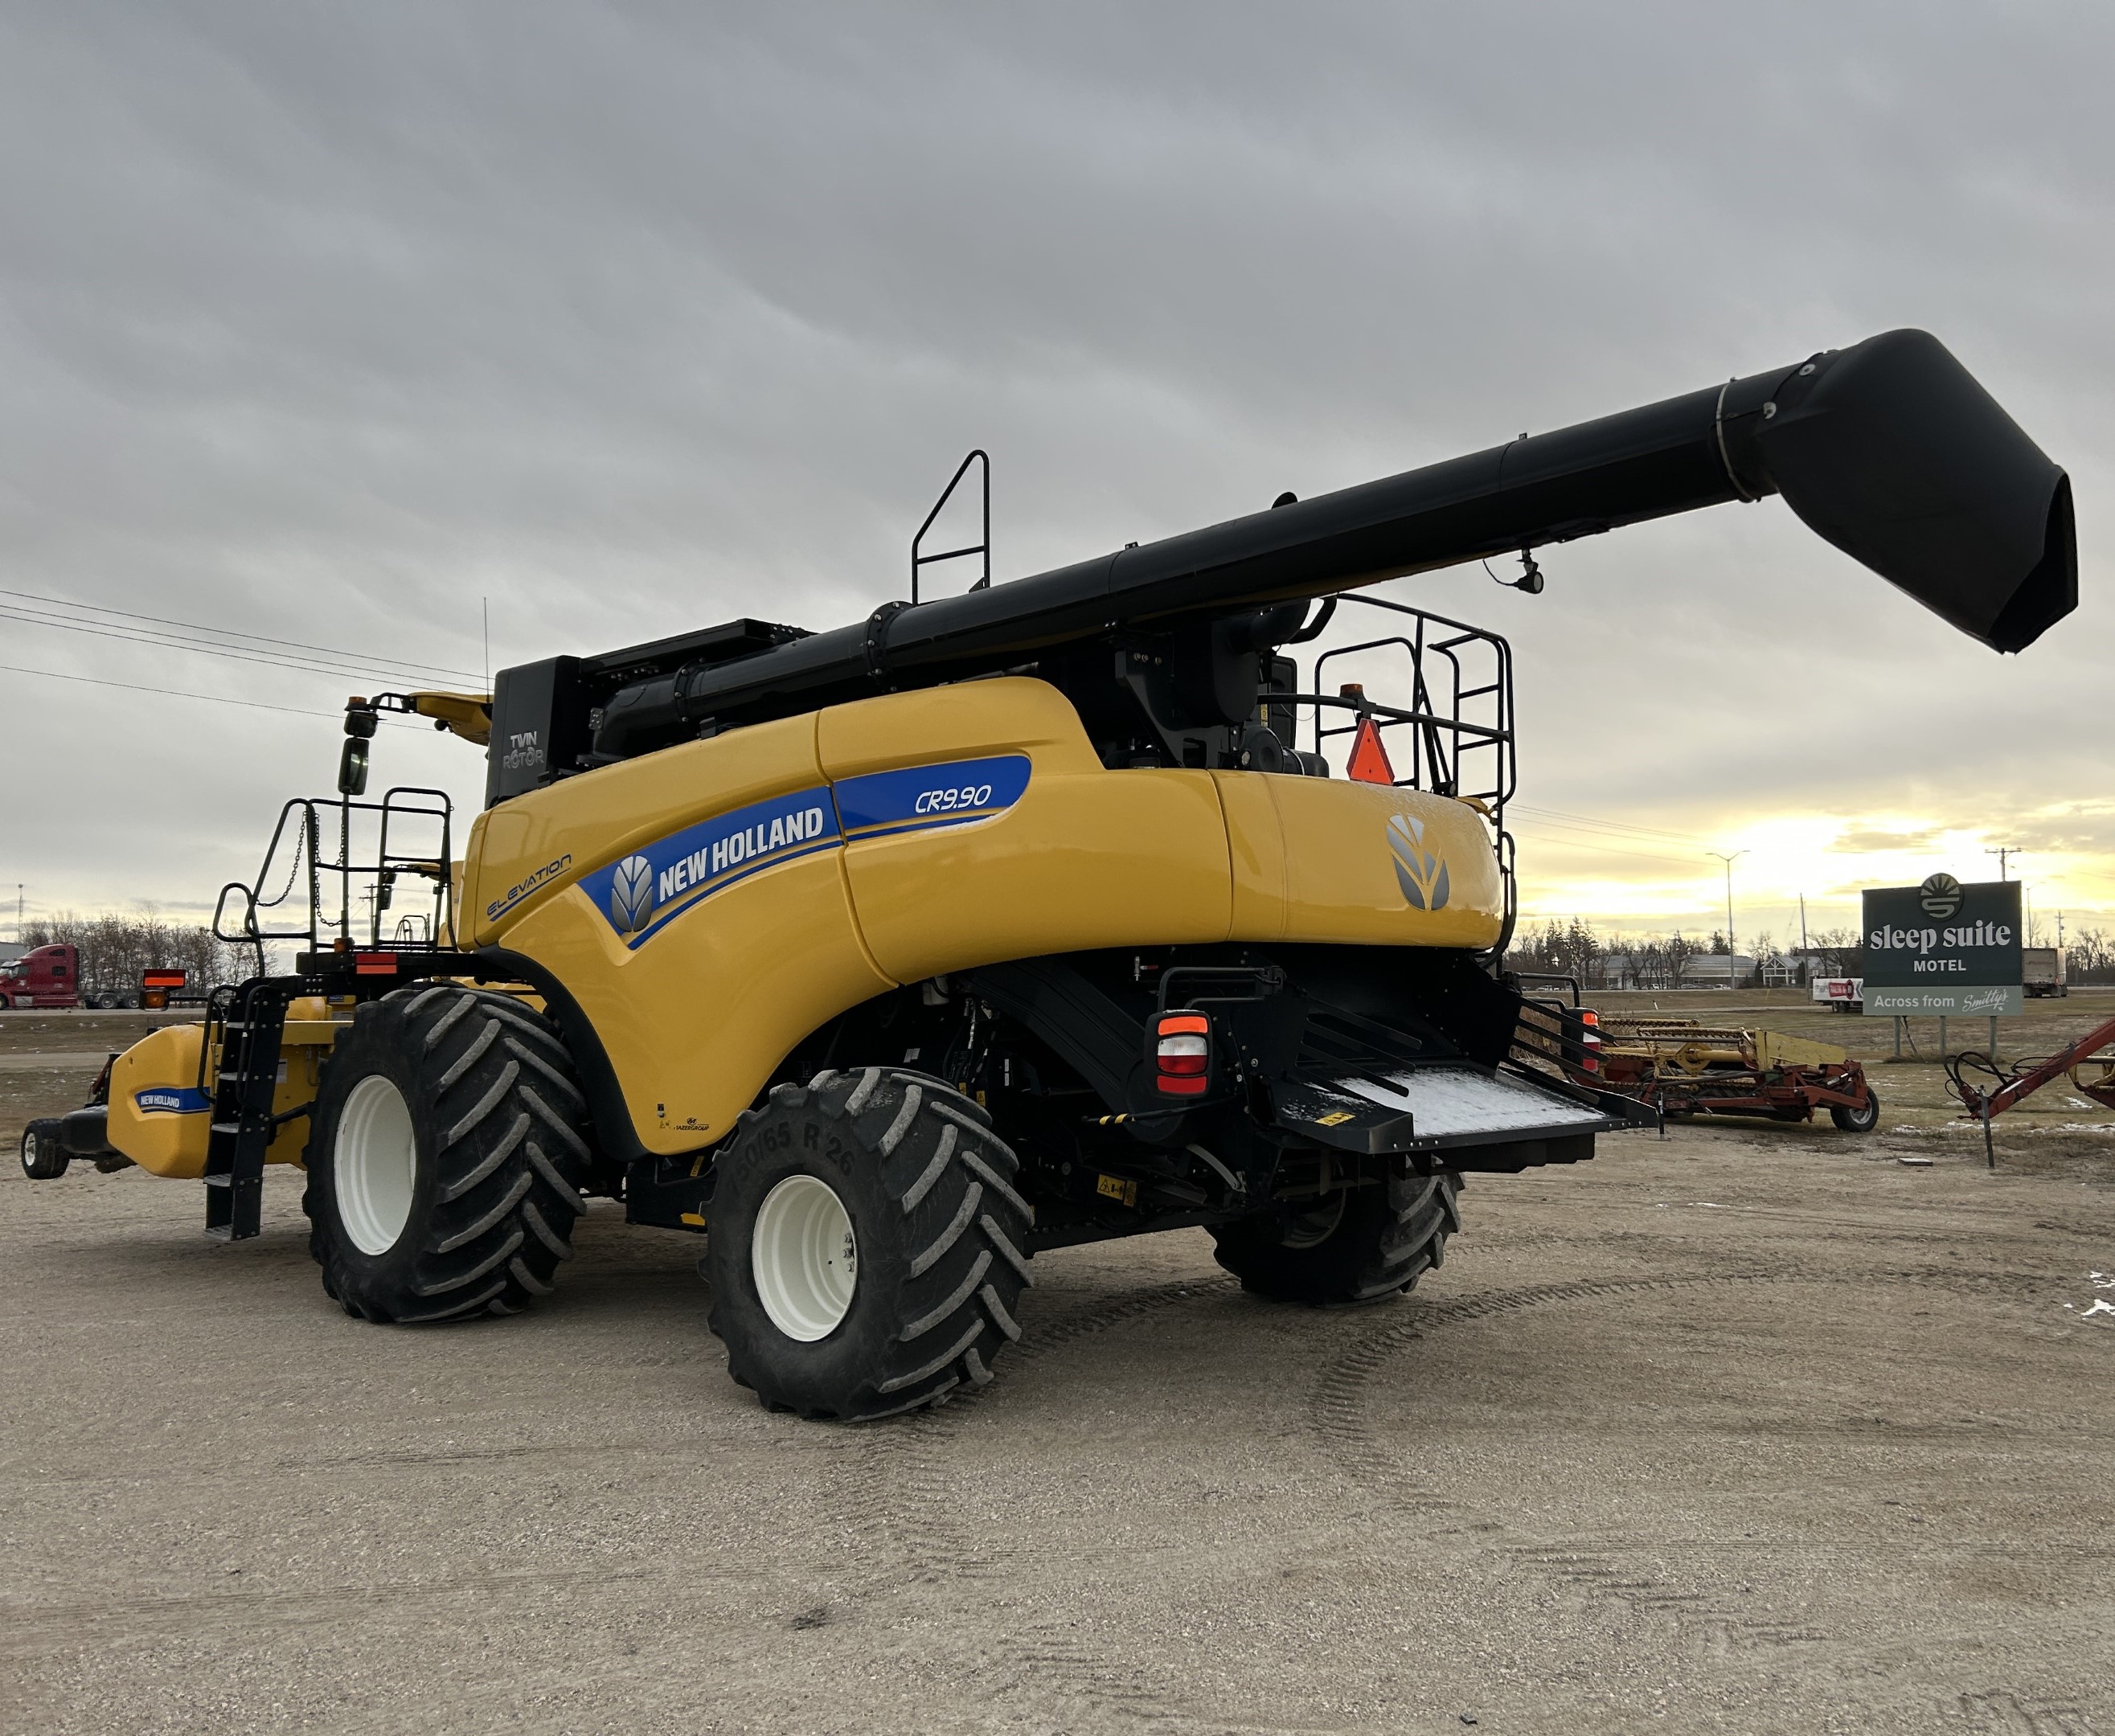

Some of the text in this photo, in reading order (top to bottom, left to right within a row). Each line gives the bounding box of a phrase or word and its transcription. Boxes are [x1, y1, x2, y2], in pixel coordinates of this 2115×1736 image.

[510, 731, 537, 749] TWIN
[503, 747, 544, 769] ROTOR
[915, 784, 992, 813] CR9.90
[659, 807, 824, 903] NEW HOLLAND
[486, 853, 572, 915] ELEVATION
[1870, 919, 2011, 955] sleep suite
[1913, 959, 1967, 972] MOTEL
[1874, 989, 2009, 1012] Across from Smitty's
[141, 1095, 180, 1108] NEW HOLLAND
[803, 1122, 820, 1150] R
